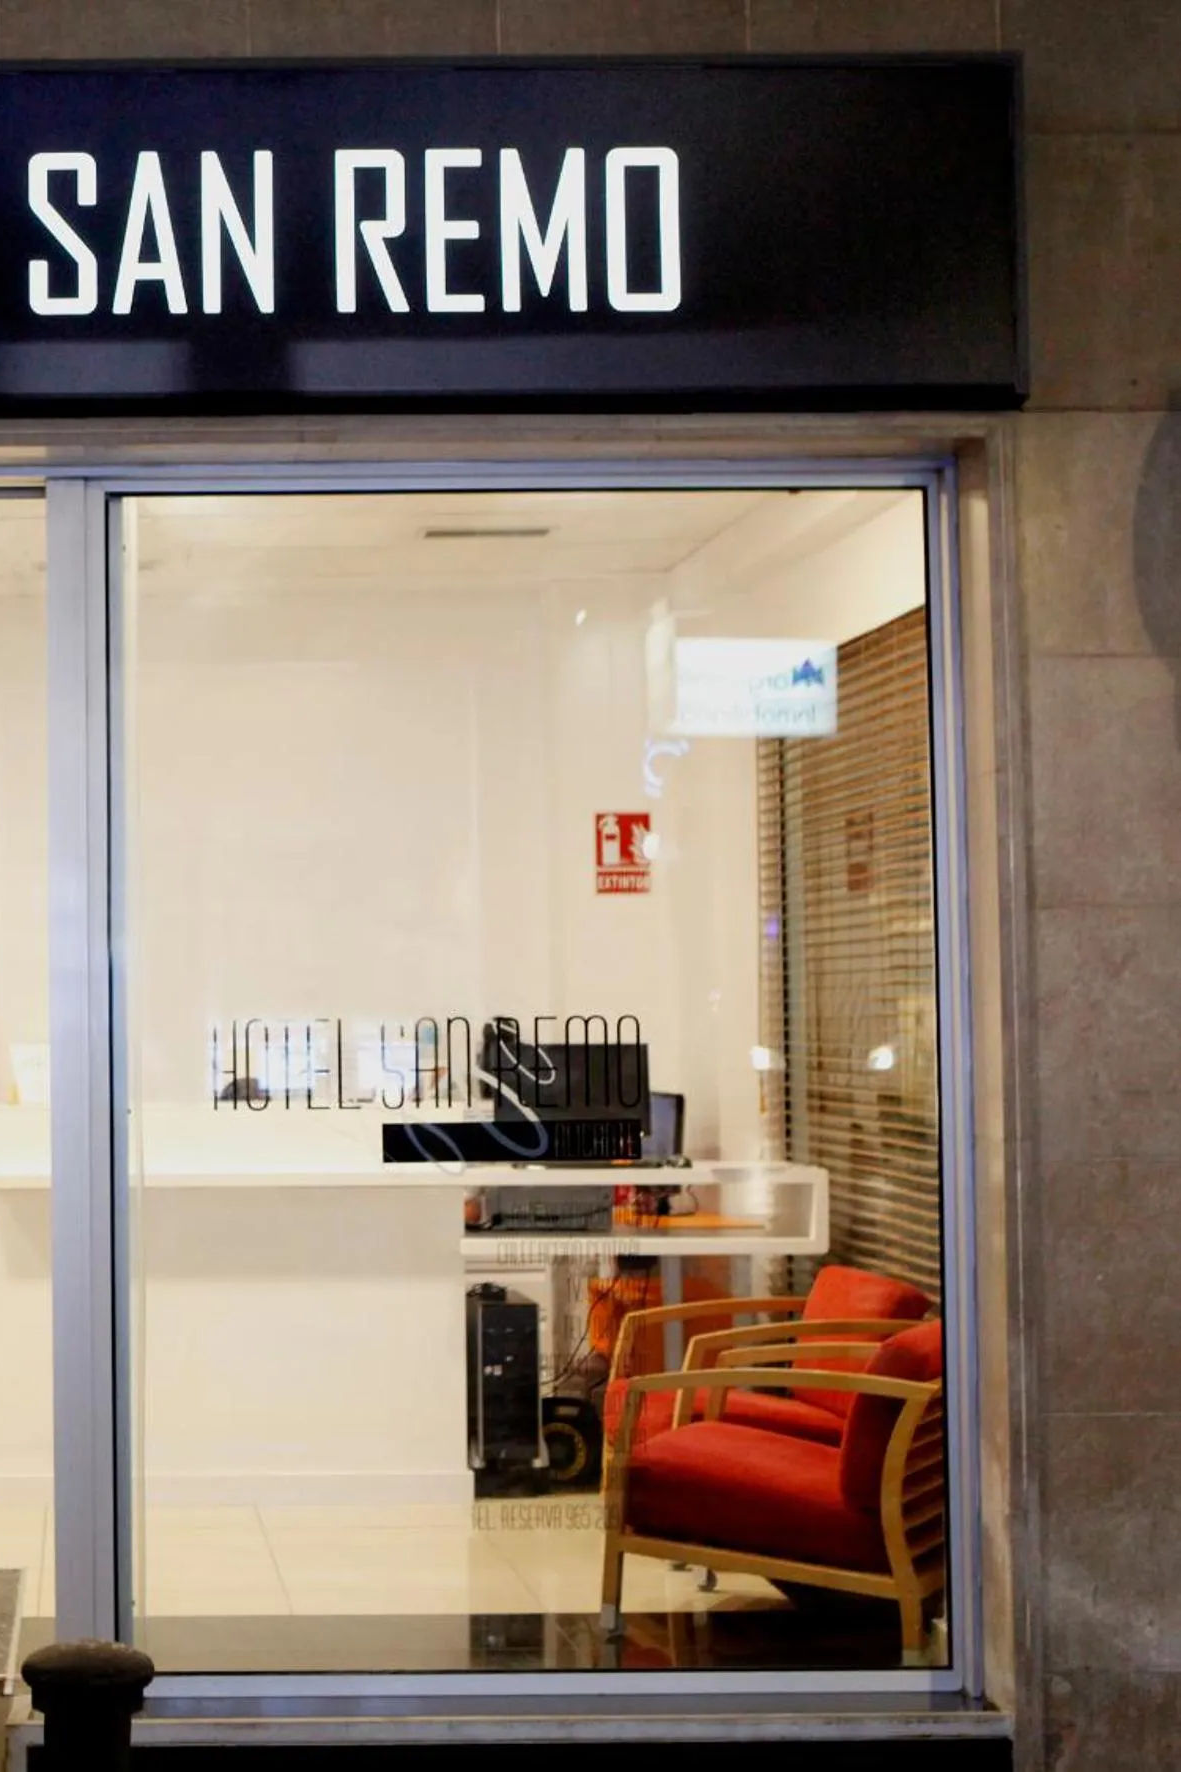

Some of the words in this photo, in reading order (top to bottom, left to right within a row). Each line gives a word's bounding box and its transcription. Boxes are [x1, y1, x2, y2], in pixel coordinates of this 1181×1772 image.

[29, 151, 274, 315] SAN
[335, 147, 680, 312] REMO
[212, 1017, 362, 1111] HOTEL
[380, 1016, 472, 1110] SAN
[494, 1014, 641, 1109] REMO
[500, 1503, 562, 1530] RESERVA
